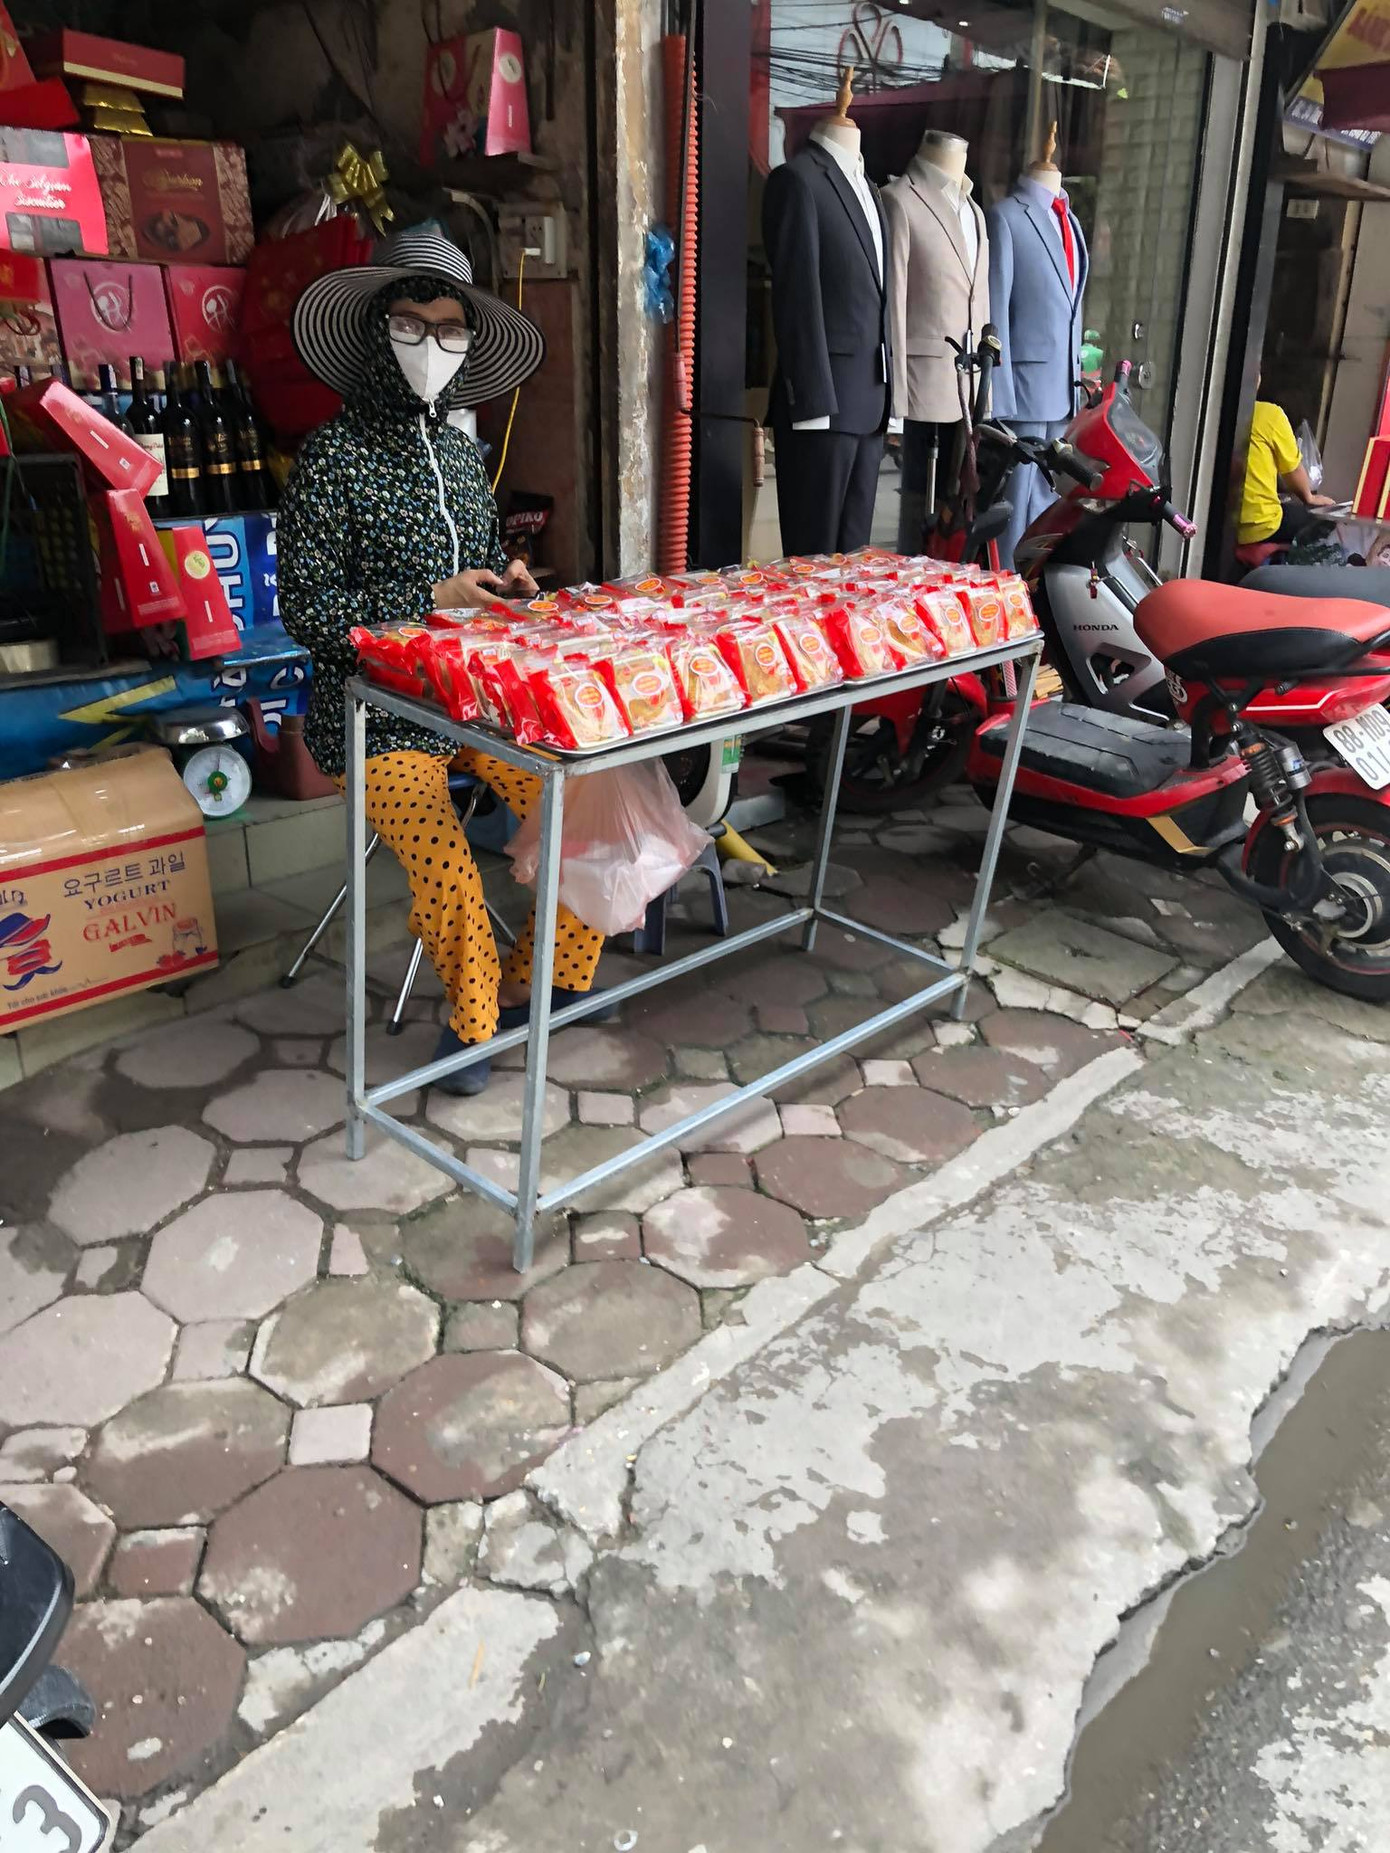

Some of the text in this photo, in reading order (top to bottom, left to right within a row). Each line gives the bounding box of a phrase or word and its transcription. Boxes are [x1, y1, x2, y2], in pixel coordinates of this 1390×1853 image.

[1073, 624, 1119, 632] HONDA
[64, 851, 185, 898] 요구르트 과일
[84, 880, 170, 910] YOGURT
[83, 902, 176, 942] GALVIN
